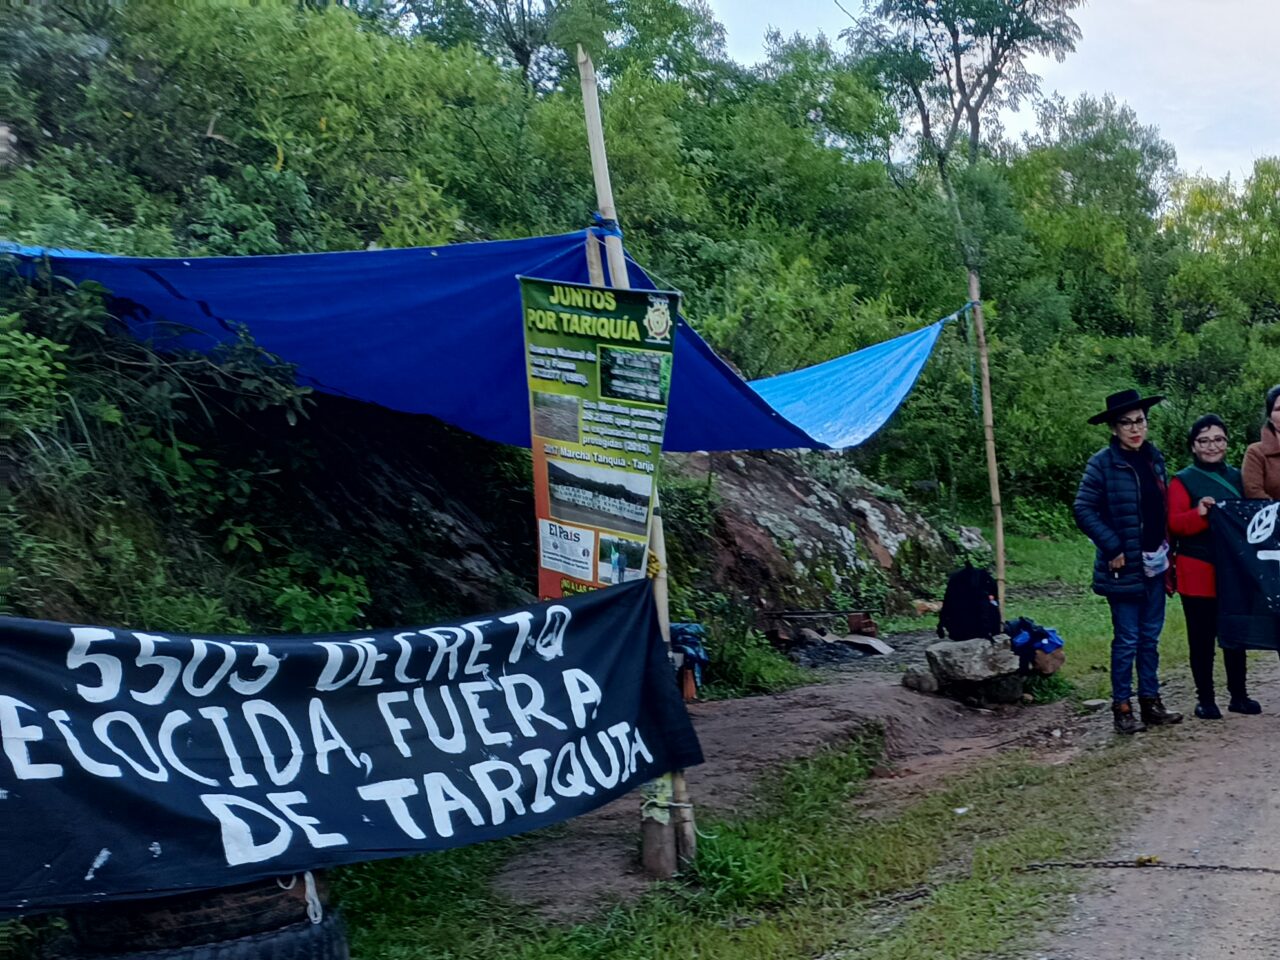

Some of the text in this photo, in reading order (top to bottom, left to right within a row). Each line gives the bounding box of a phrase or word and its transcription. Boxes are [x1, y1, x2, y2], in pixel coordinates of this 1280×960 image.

[549, 285, 617, 311] JUNTOS
[527, 308, 641, 341] POR TARIQUÍA
[560, 447, 590, 460] Marcha
[632, 459, 654, 473] Tarija
[549, 523, 558, 537] El
[66, 605, 572, 705] 5503 DECRETO
[377, 668, 602, 758] FUERA
[200, 721, 654, 867] DE TARIQUIA
